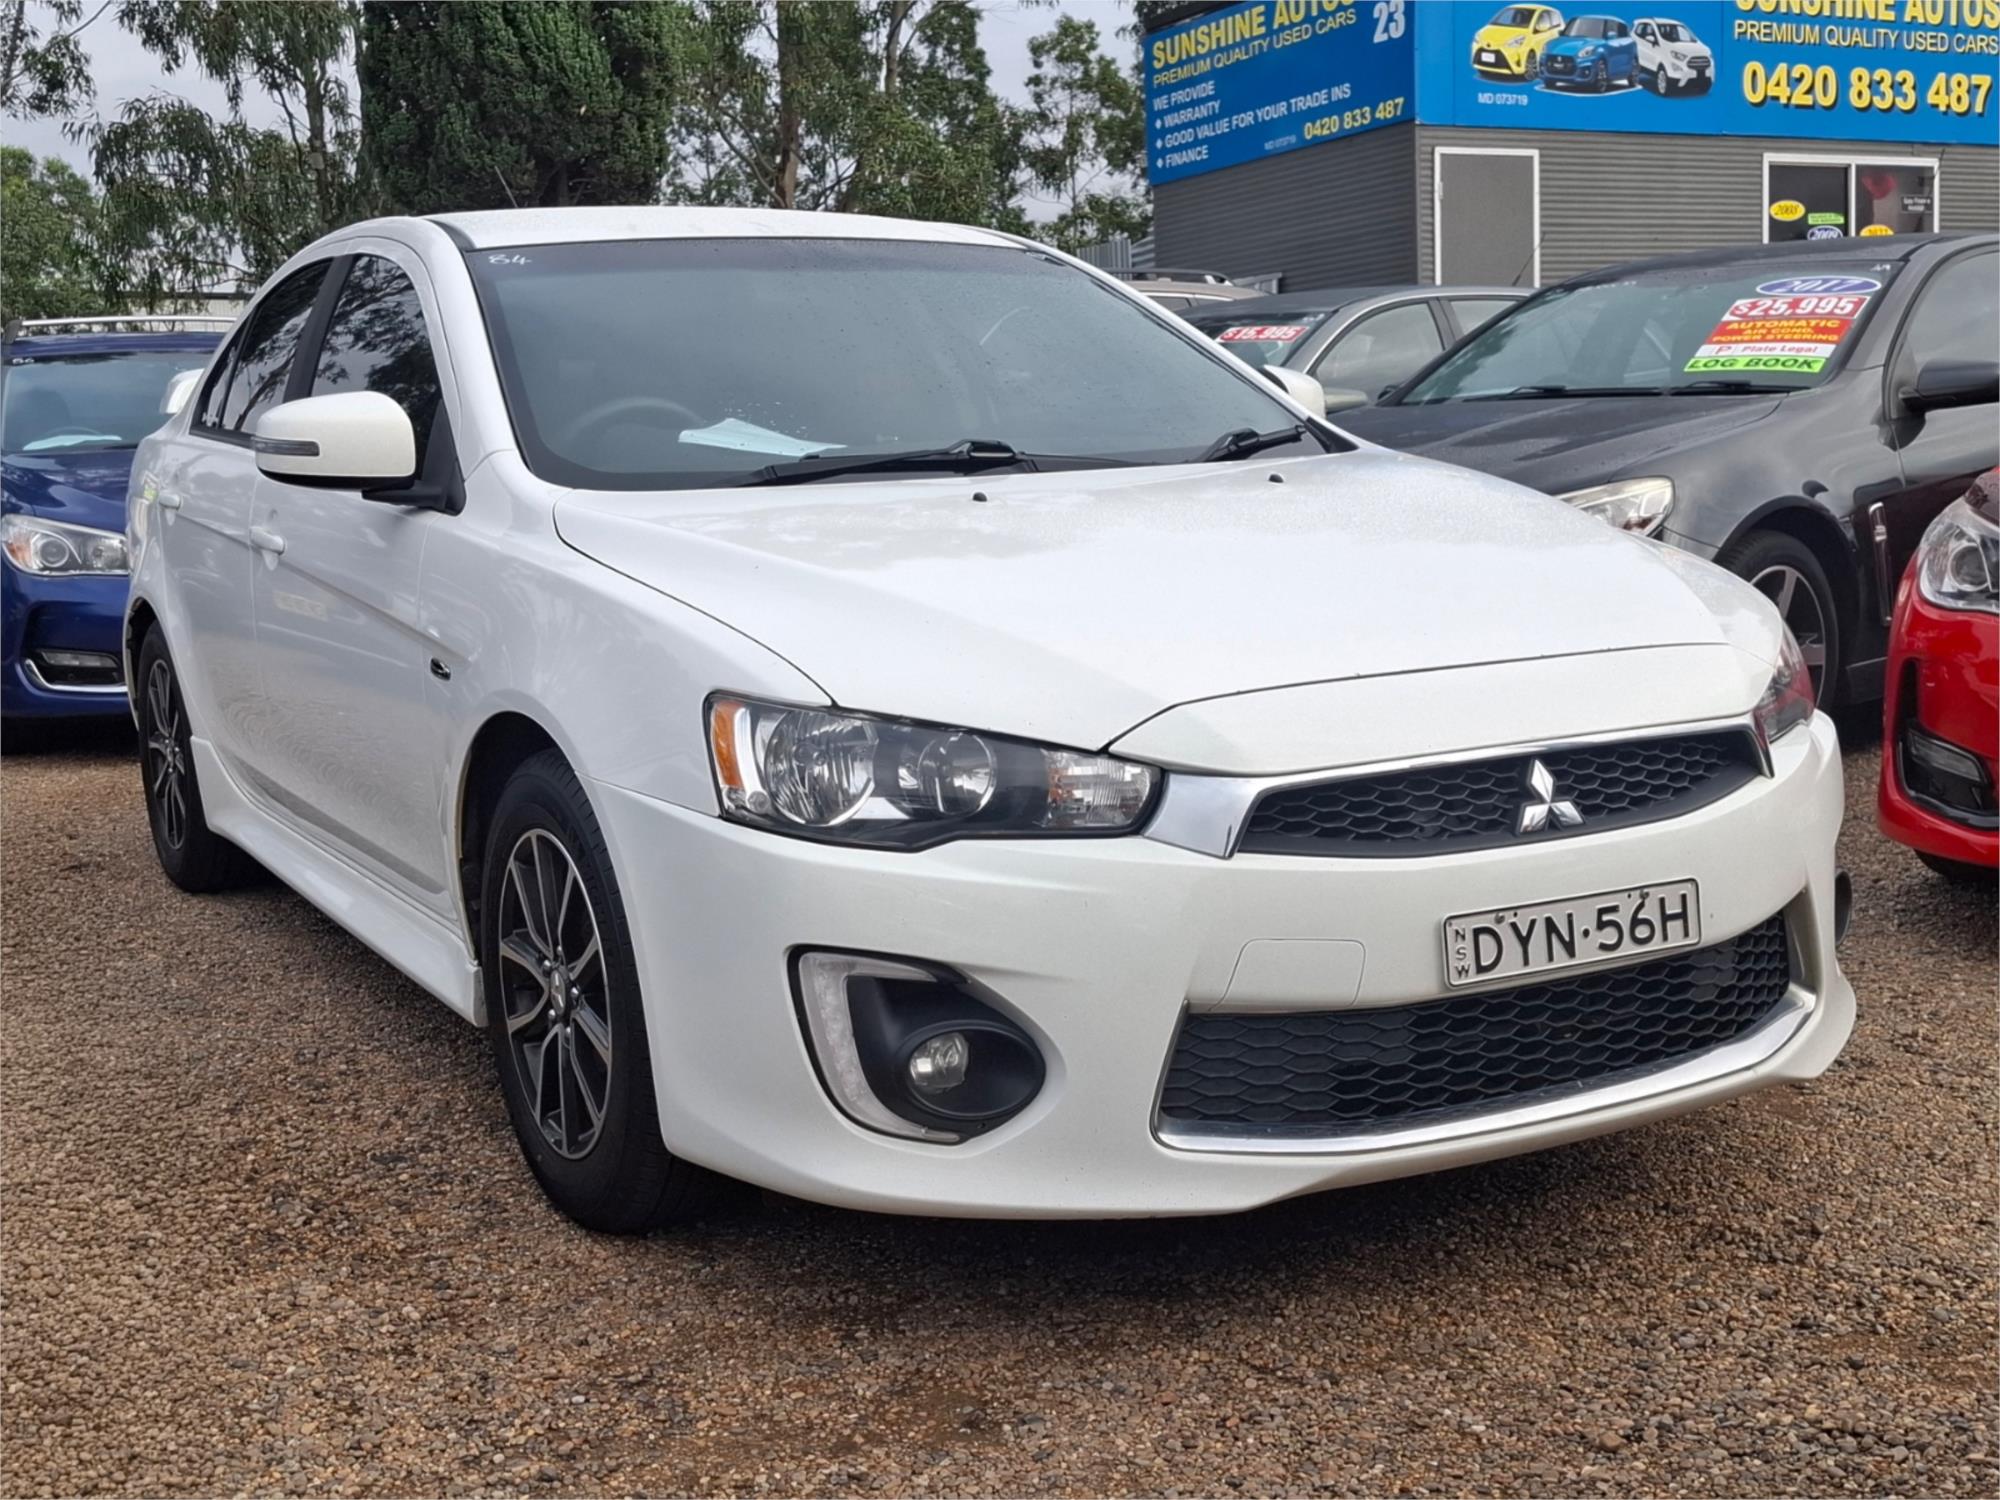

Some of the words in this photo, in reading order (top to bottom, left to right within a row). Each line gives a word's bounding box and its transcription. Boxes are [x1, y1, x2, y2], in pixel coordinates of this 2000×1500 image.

[1373, 0, 1406, 43] 23
[1153, 5, 1266, 69] SUNSHINE
[1153, 57, 1211, 88] PREMIUM
[1213, 37, 1270, 68] QUALITY
[1273, 23, 1312, 48] USED
[1315, 8, 1356, 34] CARS
[1734, 20, 1820, 44] PREMIUM
[1825, 25, 1899, 49] QUALITY
[1903, 30, 1949, 52] USED
[1953, 33, 1999, 55] CARS
[1153, 95, 1169, 111] WE
[1171, 81, 1215, 107] PROVIDE
[1743, 61, 1837, 107] 0420
[1849, 67, 1916, 111] 833
[1927, 72, 1992, 114] 487
[1164, 100, 1221, 127] WARRANTY
[1165, 130, 1194, 148] GOOD
[1196, 118, 1230, 140] VALUE
[1232, 111, 1254, 129] FOR
[1256, 103, 1288, 124] YOUR
[1289, 91, 1329, 116] TRADE
[1331, 84, 1351, 101] INS
[1304, 117, 1339, 140] 0420
[1343, 107, 1371, 129] 833
[1375, 97, 1404, 120] 487
[1165, 145, 1208, 168] FINANCE
[1775, 279, 1860, 294] 2017
[1733, 297, 1856, 317] $25,995
[1713, 334, 1762, 342] POWER
[1765, 334, 1840, 342] STEERING
[1727, 319, 1841, 330] AUTOMATIC
[1689, 358, 1736, 369] LOG
[1743, 358, 1821, 370] BOOK
[1715, 346, 1732, 355] P
[1741, 345, 1776, 354] Plate
[1780, 345, 1818, 355] Legal
